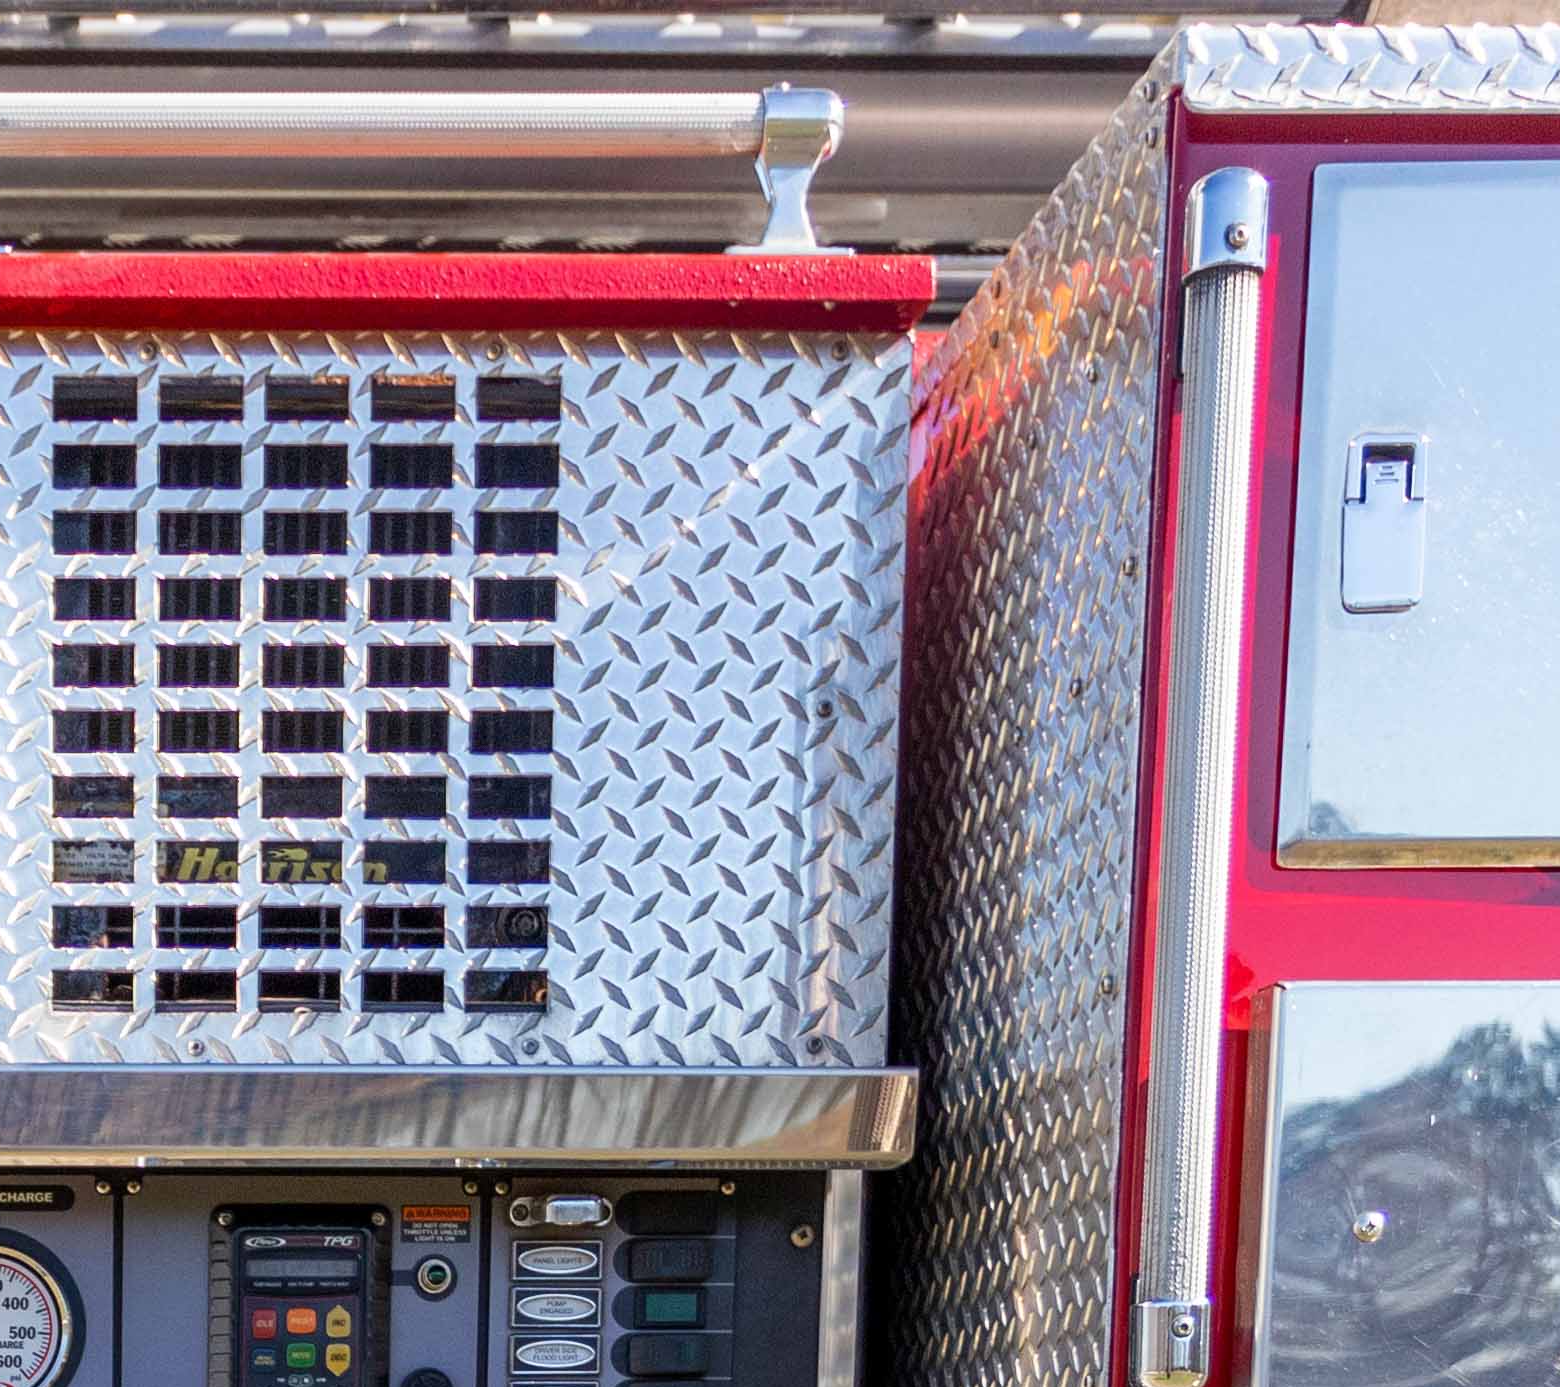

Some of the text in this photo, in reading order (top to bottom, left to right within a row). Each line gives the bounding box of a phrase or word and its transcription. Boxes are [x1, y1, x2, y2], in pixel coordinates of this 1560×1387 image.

[323, 1236, 354, 1246] TPG
[2, 1297, 29, 1310] 400
[9, 1326, 36, 1339] 500
